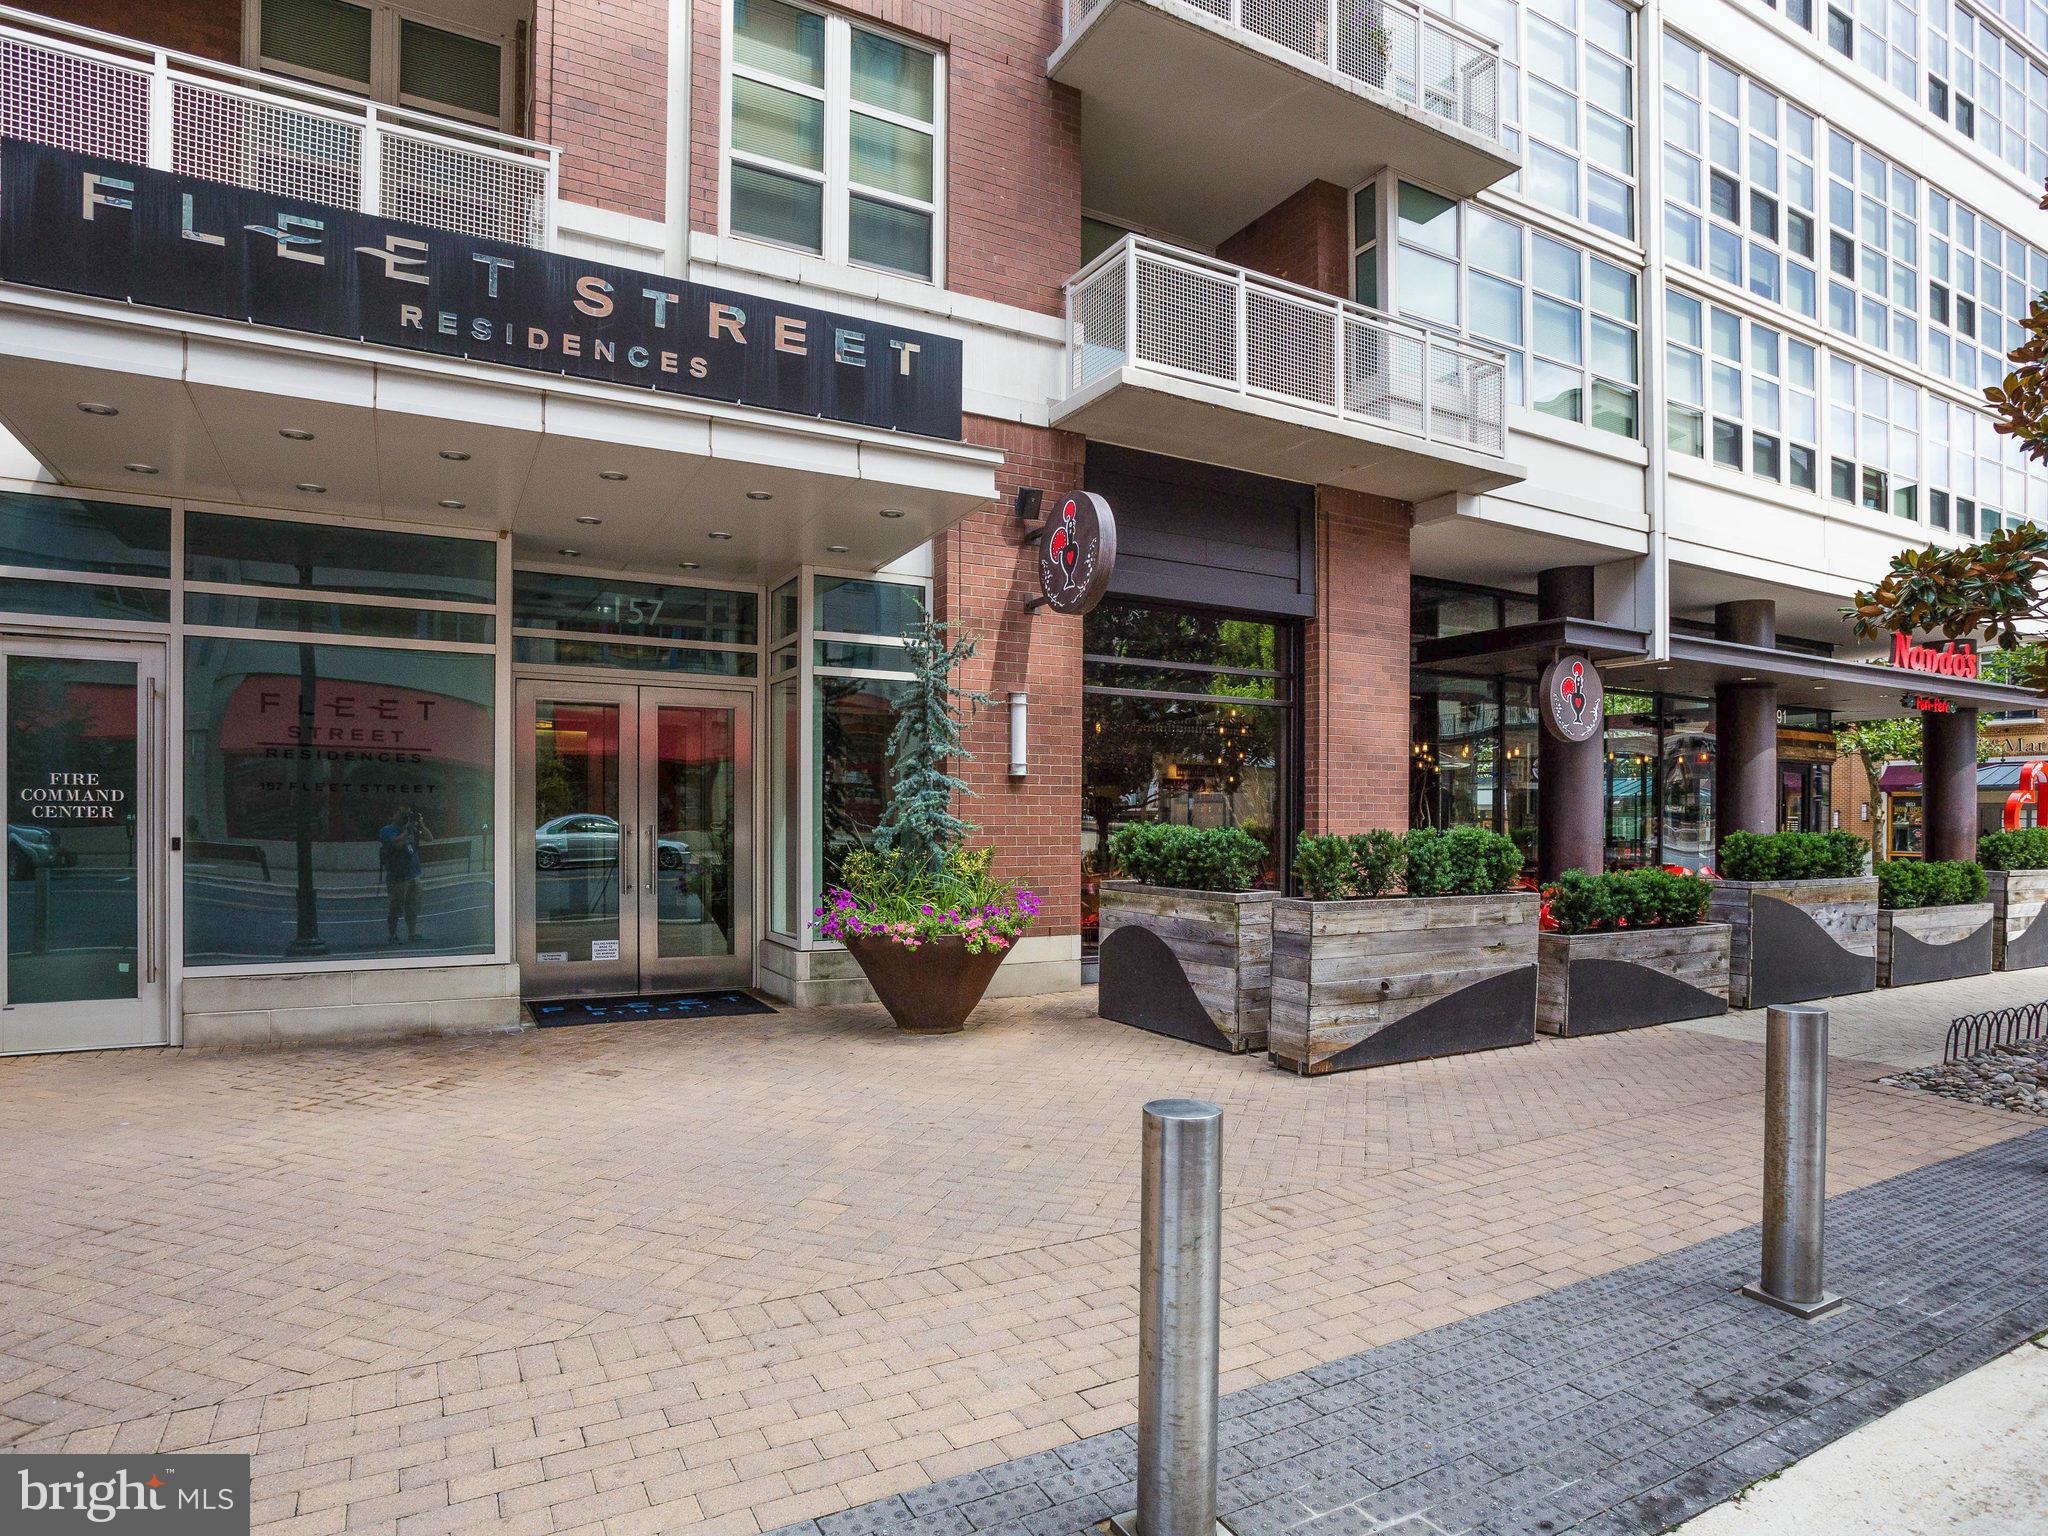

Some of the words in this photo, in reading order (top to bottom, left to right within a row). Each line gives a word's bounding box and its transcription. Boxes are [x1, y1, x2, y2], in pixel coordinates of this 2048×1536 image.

[82, 171, 516, 299] FLEET
[573, 275, 922, 376] STREET
[400, 303, 709, 379] RESIDENCES
[614, 595, 664, 626] 157
[1892, 631, 1977, 679] Nando's
[260, 692, 436, 721] FLEET
[287, 725, 404, 743] STREET
[2004, 737, 2048, 752] Mar
[265, 747, 422, 763] RESIDENCES
[50, 772, 99, 785] FIRE
[21, 788, 125, 802] COMMAND
[289, 782, 352, 793] FLEET
[360, 783, 437, 794] STREET
[32, 805, 115, 819] CENTER
